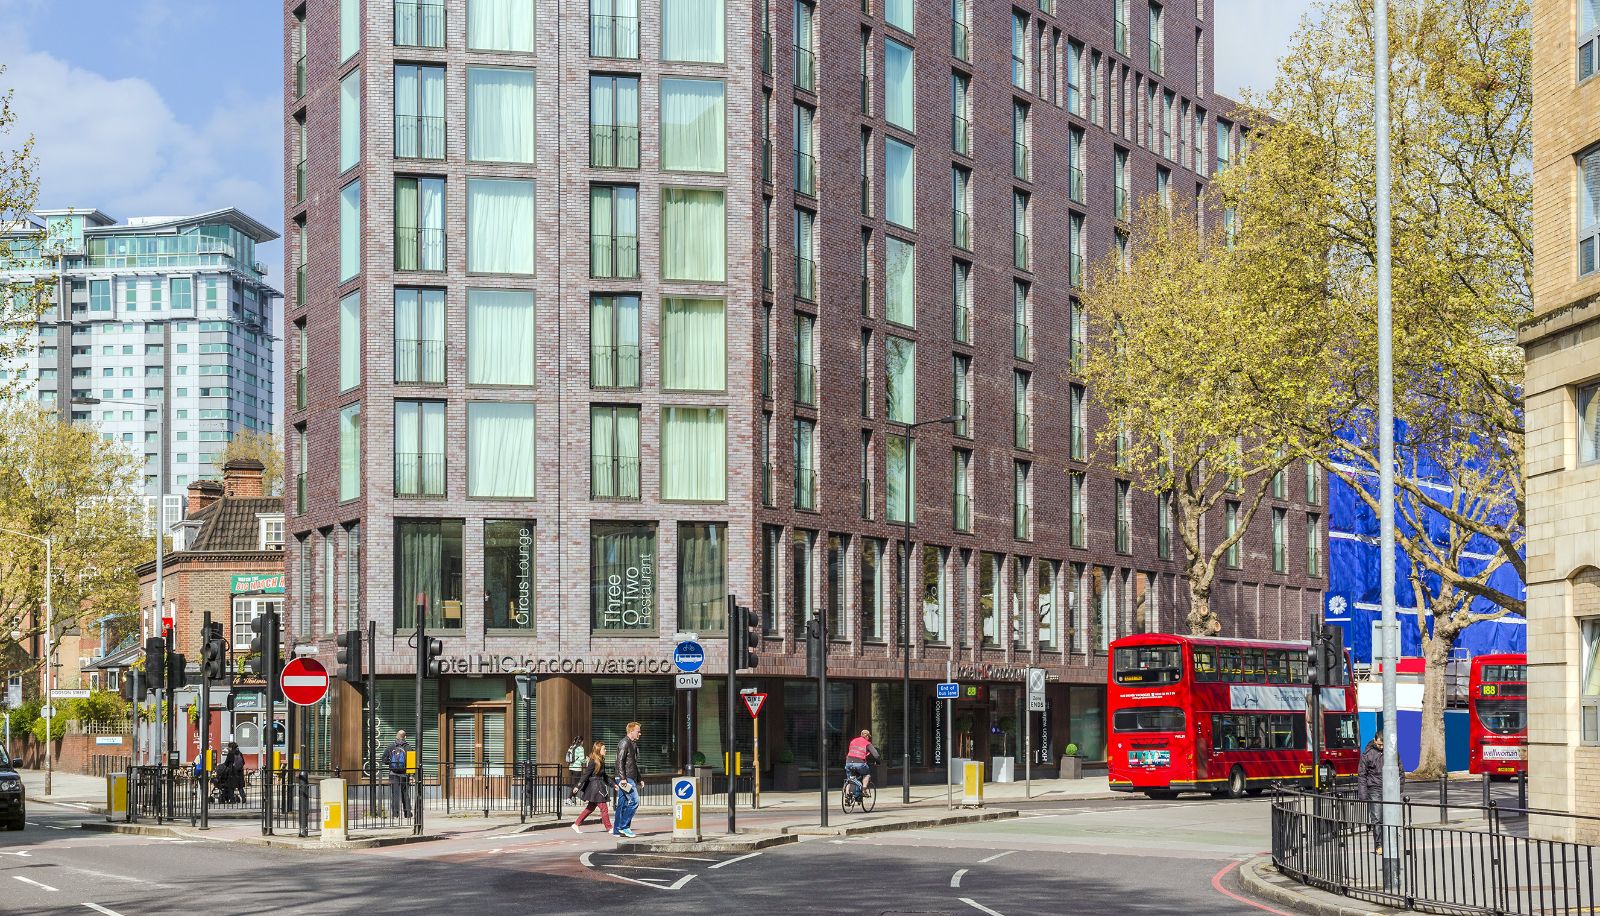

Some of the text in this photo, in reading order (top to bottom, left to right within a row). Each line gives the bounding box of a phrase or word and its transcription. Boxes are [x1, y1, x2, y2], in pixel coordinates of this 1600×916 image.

[516, 528, 532, 625] Circus Lounge
[639, 553, 652, 625] Restaurant
[604, 574, 621, 627] Three
[440, 655, 472, 673] otel
[593, 655, 672, 673] waterloo
[679, 677, 699, 686] Only
[1483, 685, 1496, 695] 188
[1483, 748, 1518, 757] wellwoman
